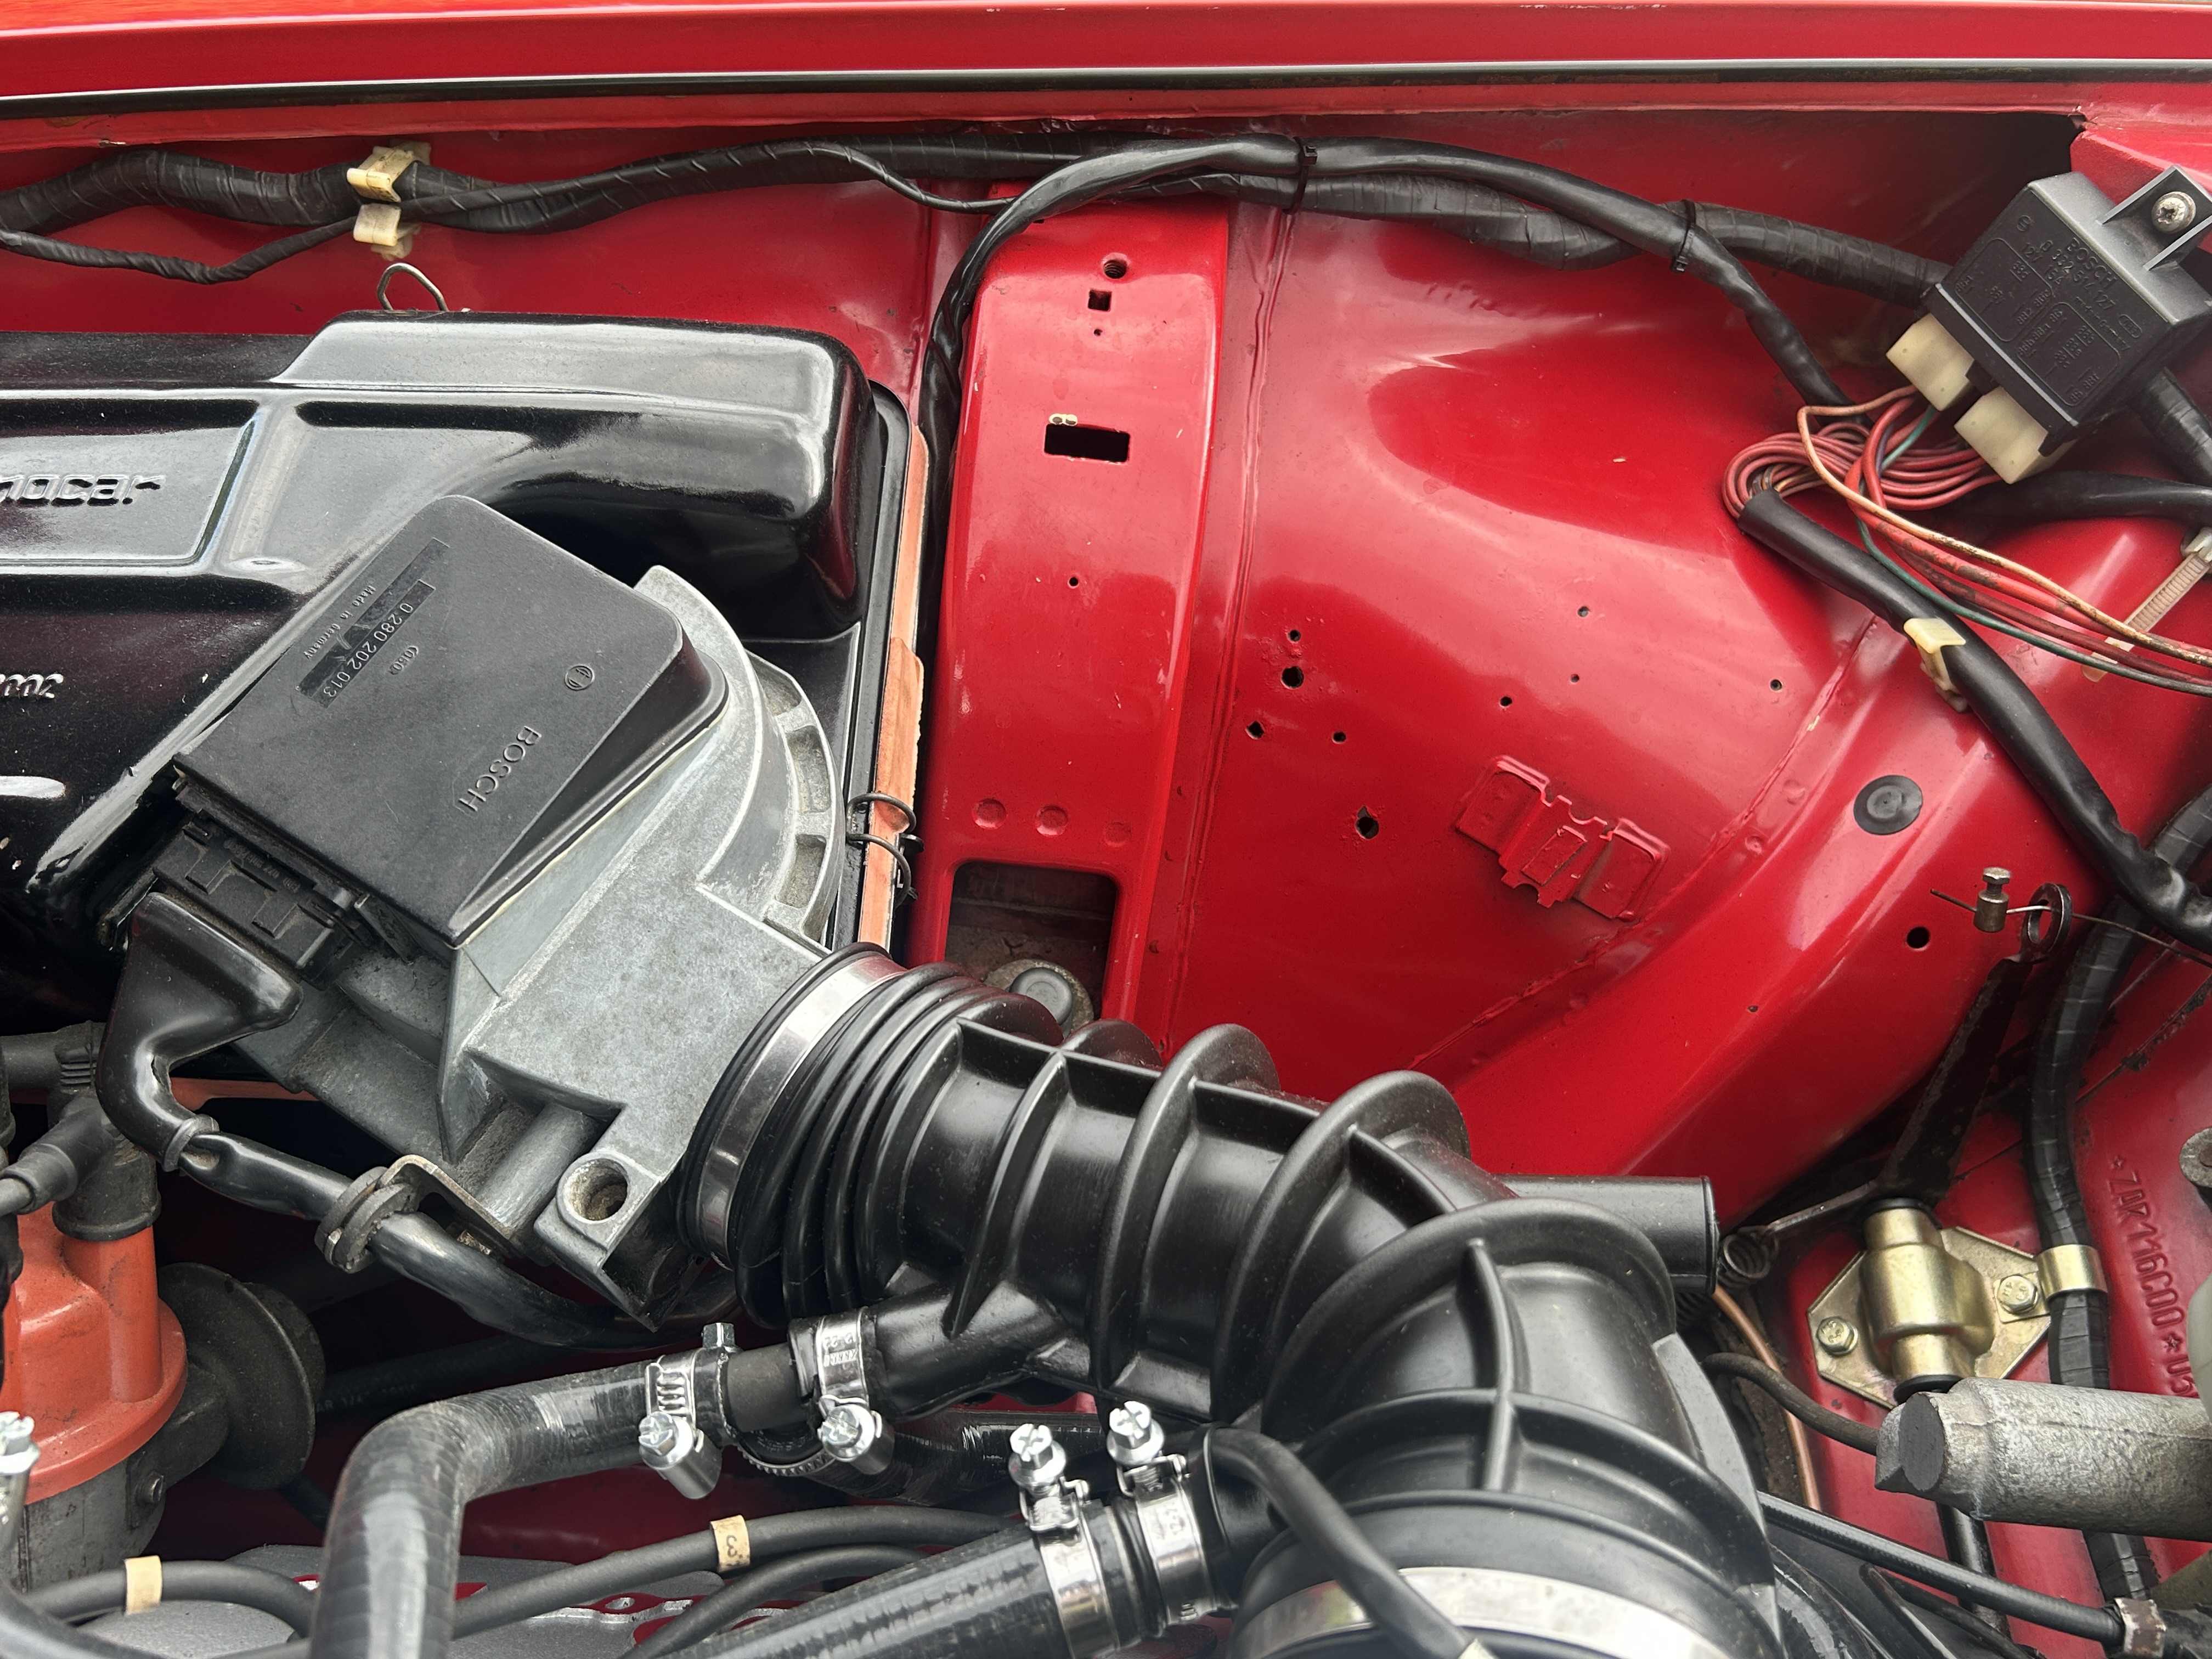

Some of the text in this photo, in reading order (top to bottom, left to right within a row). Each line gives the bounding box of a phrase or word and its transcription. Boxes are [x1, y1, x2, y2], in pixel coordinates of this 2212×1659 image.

[2052, 249, 2074, 274] 332
[2067, 236, 2118, 289] BOSCH
[303, 585, 376, 660] Made in Germany
[323, 602, 414, 698] 0 280 202 013
[458, 725, 542, 813] BOSCH
[2106, 1169, 2185, 1327] ZAR116C00
[726, 1534, 738, 1558] 3
